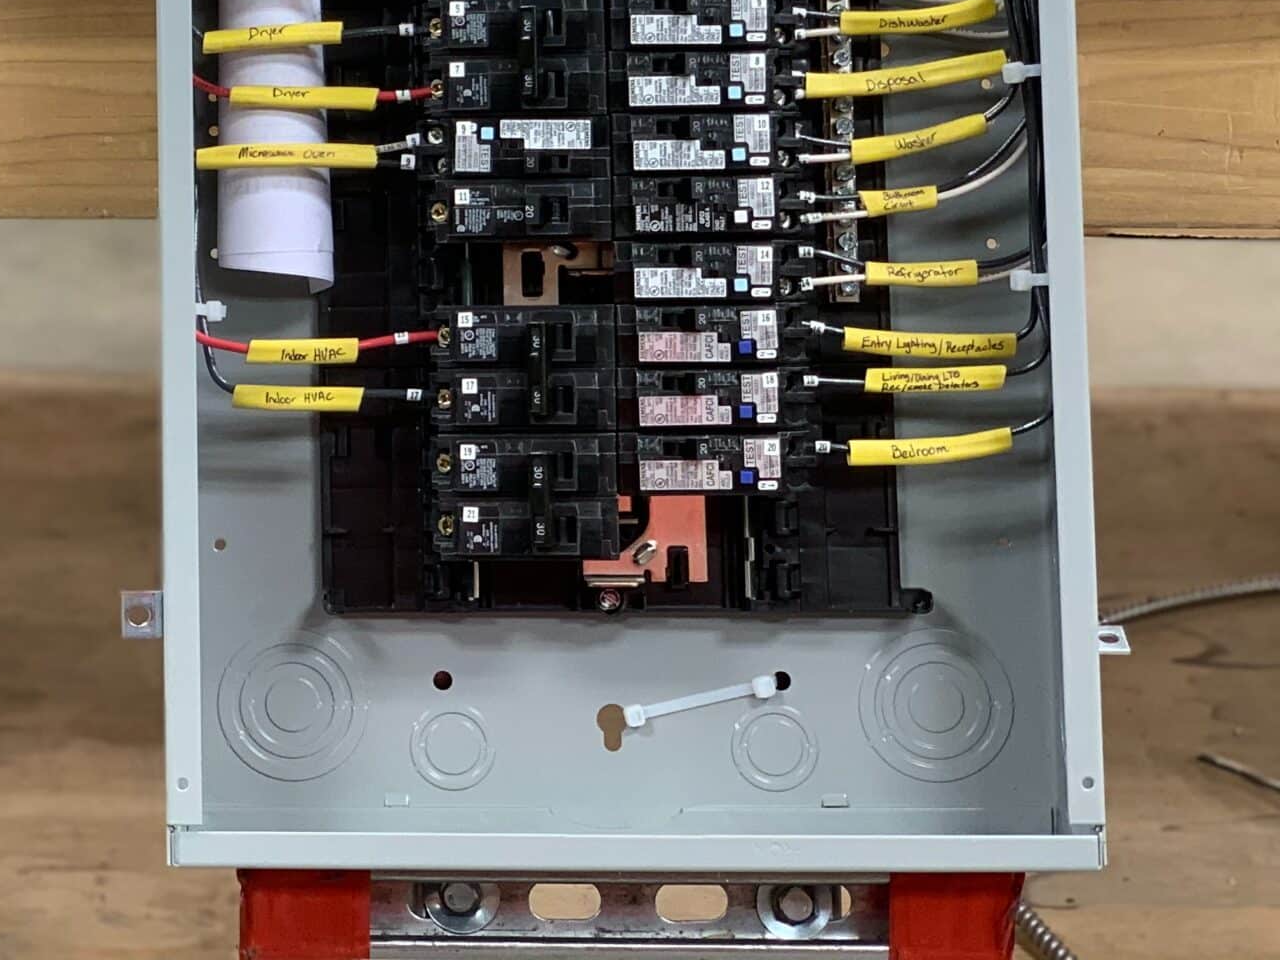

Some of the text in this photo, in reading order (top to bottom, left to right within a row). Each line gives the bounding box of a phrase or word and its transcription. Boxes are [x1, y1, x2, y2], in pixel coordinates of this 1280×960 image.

[879, 15, 948, 29] Dishwasher
[248, 25, 286, 40] Dryer
[731, 55, 740, 78] TEST
[865, 72, 926, 92] Disposal
[272, 87, 310, 98] Dryer
[736, 116, 744, 139] TEST
[894, 131, 937, 151] Washer
[303, 150, 335, 159] Oven
[481, 146, 490, 171] TEST
[526, 156, 535, 168] 20
[739, 180, 748, 204] TEST
[761, 182, 770, 190] 12
[525, 205, 535, 218] 20
[738, 247, 746, 270] TEST
[761, 250, 769, 259] 14
[886, 265, 965, 283] Refrigerator
[742, 313, 751, 336] TEST
[761, 313, 770, 322] 16
[705, 335, 714, 359] CAFCI
[861, 337, 892, 352] Entry
[281, 347, 346, 361] Indoor HVAC
[766, 375, 774, 384] 18
[743, 375, 752, 400] TEST
[265, 391, 335, 404] Indoor HVAC
[706, 398, 714, 422] CAFCI
[745, 441, 754, 465] TEST
[891, 444, 950, 460] Bedroom
[533, 465, 543, 480] 30
[706, 463, 714, 486] CAFCI
[536, 522, 545, 536] 30
